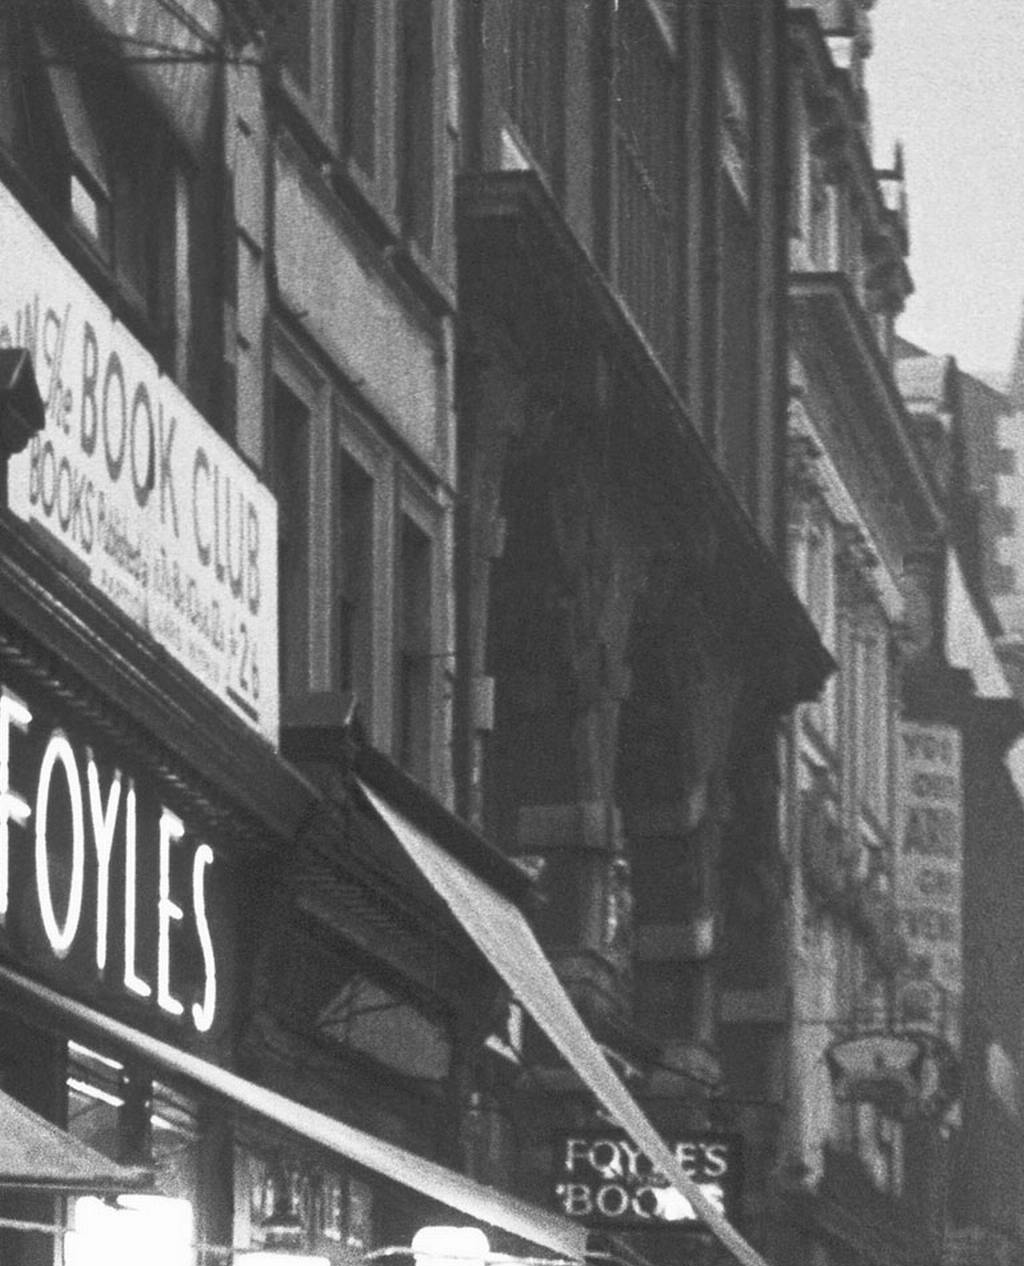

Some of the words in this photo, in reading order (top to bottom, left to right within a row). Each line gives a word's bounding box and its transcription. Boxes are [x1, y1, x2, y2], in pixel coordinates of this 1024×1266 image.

[29, 432, 95, 555] BOOKS
[79, 320, 180, 540] BOOK
[192, 445, 261, 616] CLUB
